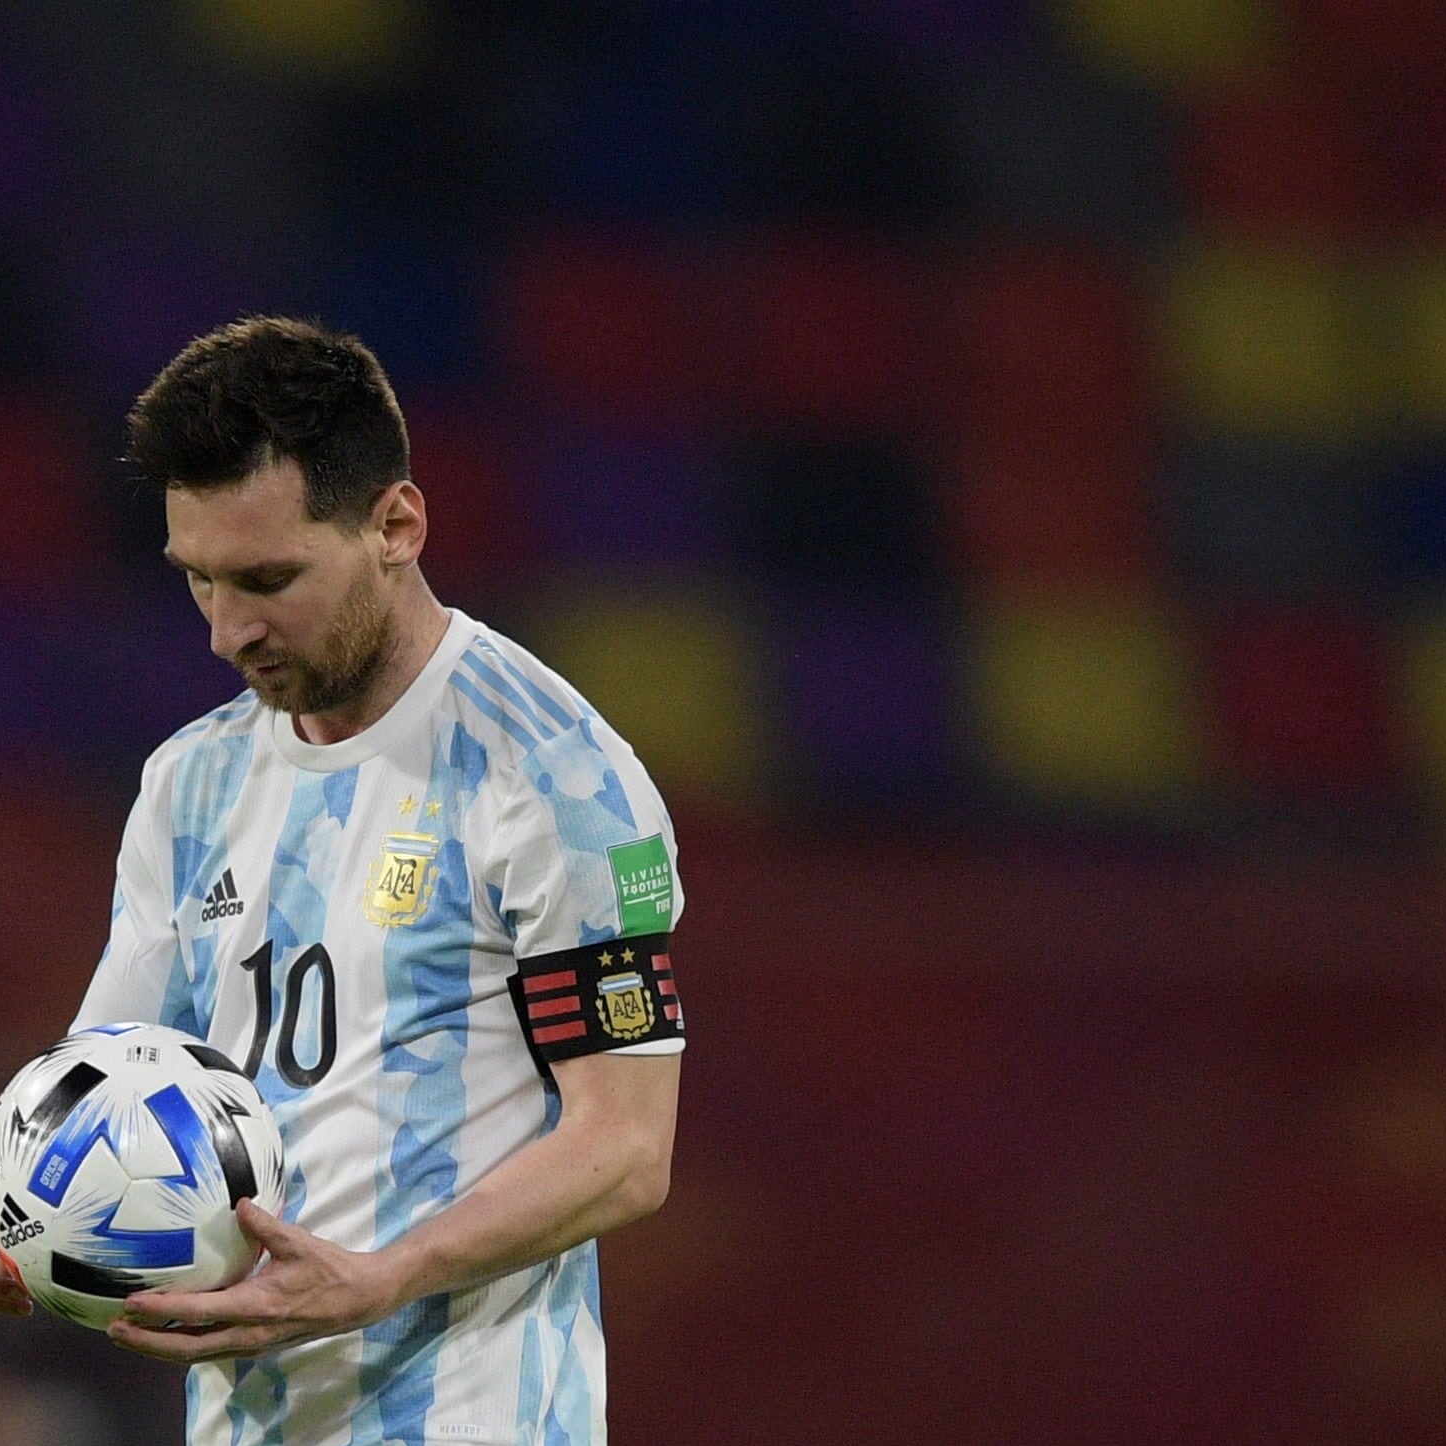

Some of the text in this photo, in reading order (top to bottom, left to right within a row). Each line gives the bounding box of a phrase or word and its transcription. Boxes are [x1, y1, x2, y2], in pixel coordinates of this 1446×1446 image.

[378, 855, 417, 902] AFA
[620, 862, 669, 886] LIVING
[622, 874, 670, 897] FOOTBALL
[201, 899, 244, 922] adidas
[240, 938, 337, 1090] 10
[613, 990, 642, 1019] AFA
[0, 1219, 45, 1249] adidas
